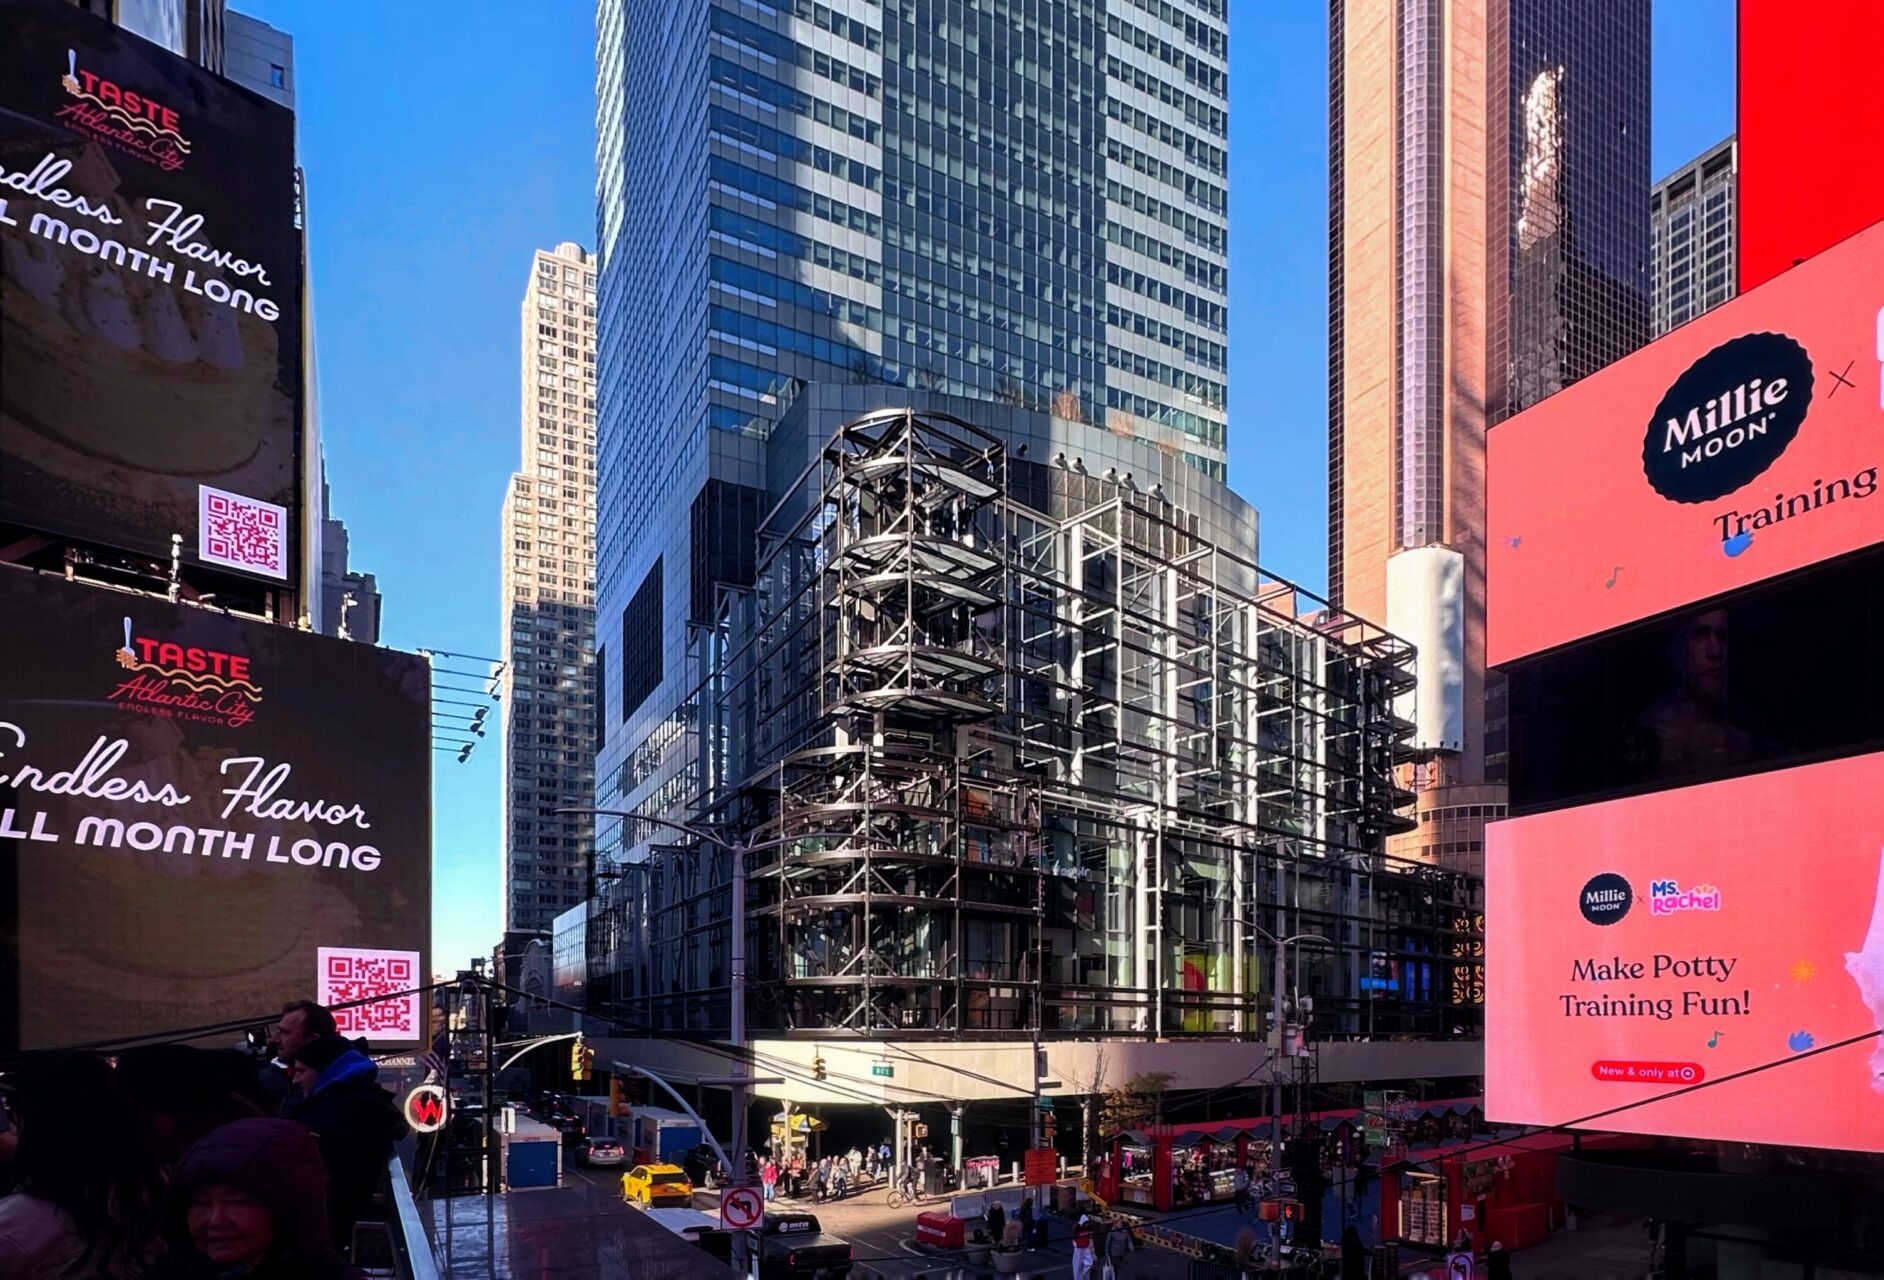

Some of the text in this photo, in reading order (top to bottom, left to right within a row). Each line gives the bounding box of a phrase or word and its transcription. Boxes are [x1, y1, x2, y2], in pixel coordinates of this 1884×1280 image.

[80, 69, 180, 133] TASTE
[54, 102, 185, 171] Atlantic City
[29, 213, 175, 283] MONTH
[184, 270, 280, 321] LONG
[145, 198, 271, 286] Flavor
[1663, 378, 1788, 452] Millie
[1681, 417, 1767, 468] MOON
[1713, 467, 1878, 542] Training
[136, 637, 250, 680] TASTE
[107, 674, 255, 727] Atlantic City
[118, 702, 224, 725] ENDLESS FLAVOR
[220, 756, 371, 829] Flavor
[75, 816, 255, 860] MONTH
[266, 835, 382, 871] LONG
[1586, 889, 1626, 904] Millie
[1591, 903, 1620, 912] MOON
[1653, 892, 1719, 914] Rachel
[1571, 954, 1738, 983] Make Potty
[1559, 989, 1750, 1021] Training Fun!
[1600, 1066, 1679, 1079] New & only at
[412, 1098, 444, 1124] W
